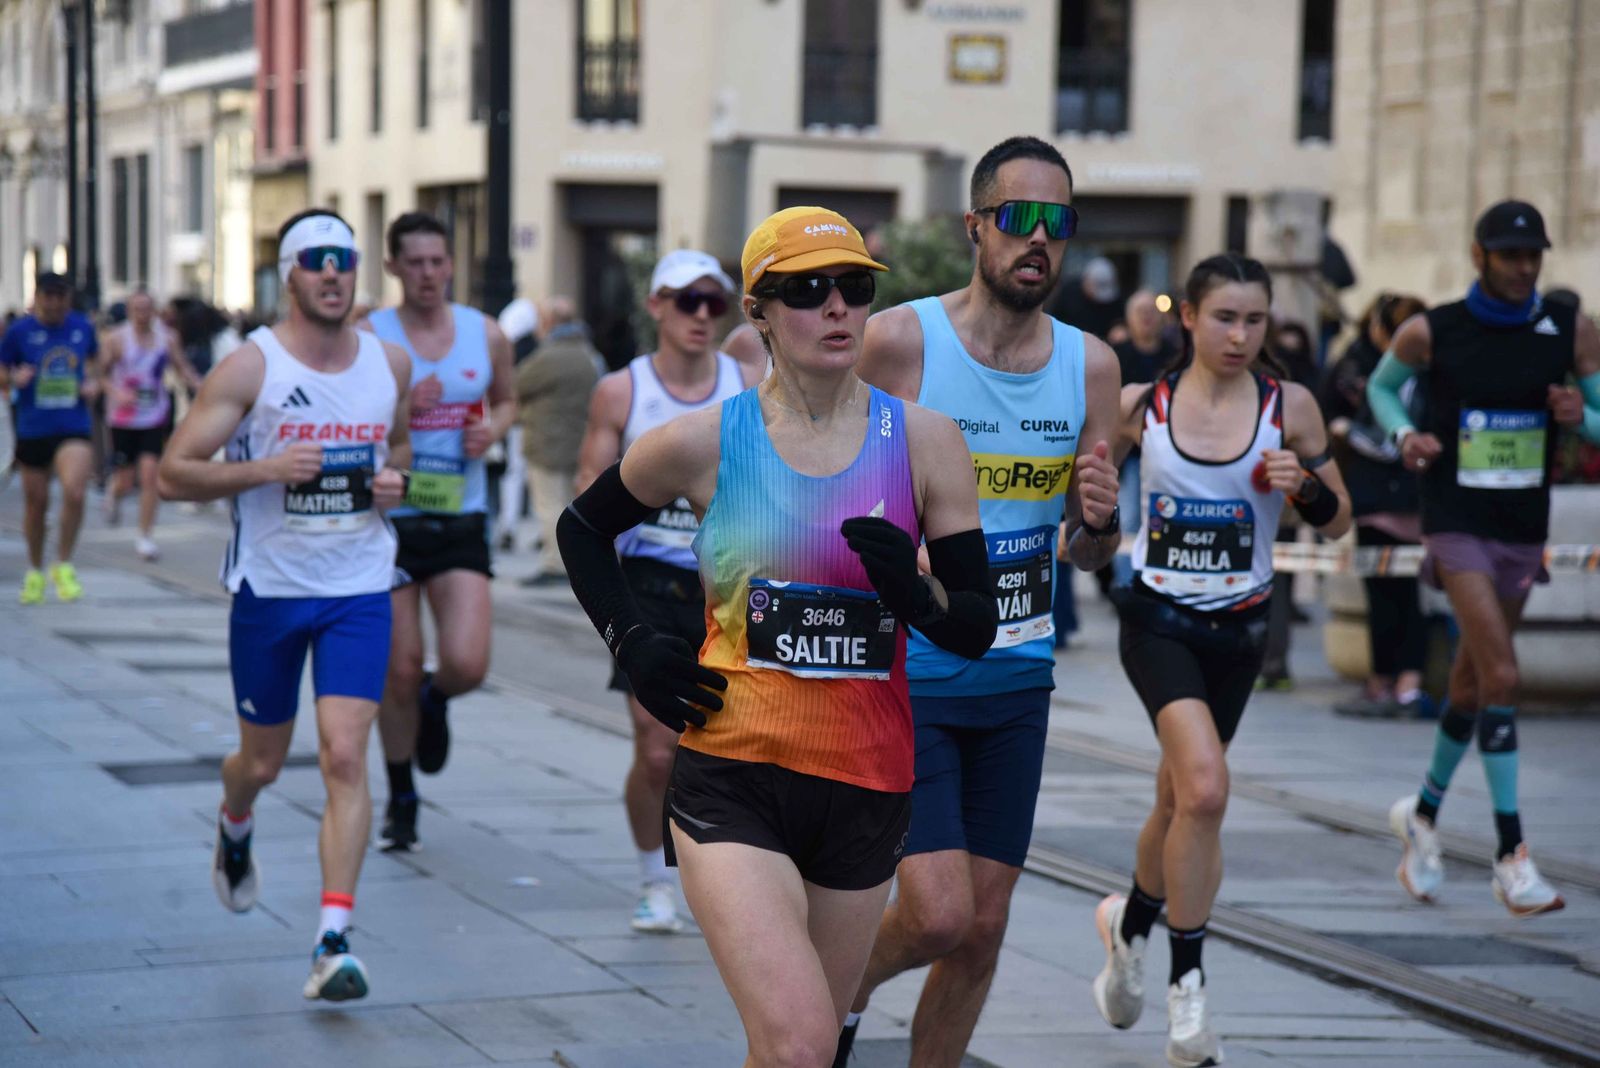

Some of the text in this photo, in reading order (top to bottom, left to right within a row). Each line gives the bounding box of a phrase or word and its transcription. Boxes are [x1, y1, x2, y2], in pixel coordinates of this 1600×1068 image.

[804, 223, 848, 235] CAMINO
[881, 403, 892, 438] soar
[952, 417, 999, 434] Digital
[1020, 419, 1069, 432] CURVA
[279, 422, 385, 443] FRANCE
[287, 492, 353, 514] MATHIS
[1182, 502, 1244, 519] ZURICH
[995, 532, 1045, 555] ZURICH
[1167, 547, 1231, 571] PAULA
[997, 571, 1027, 589] 4291
[996, 590, 1032, 620] VÁN
[801, 608, 846, 626] 3646
[775, 633, 867, 665] SALTIE
